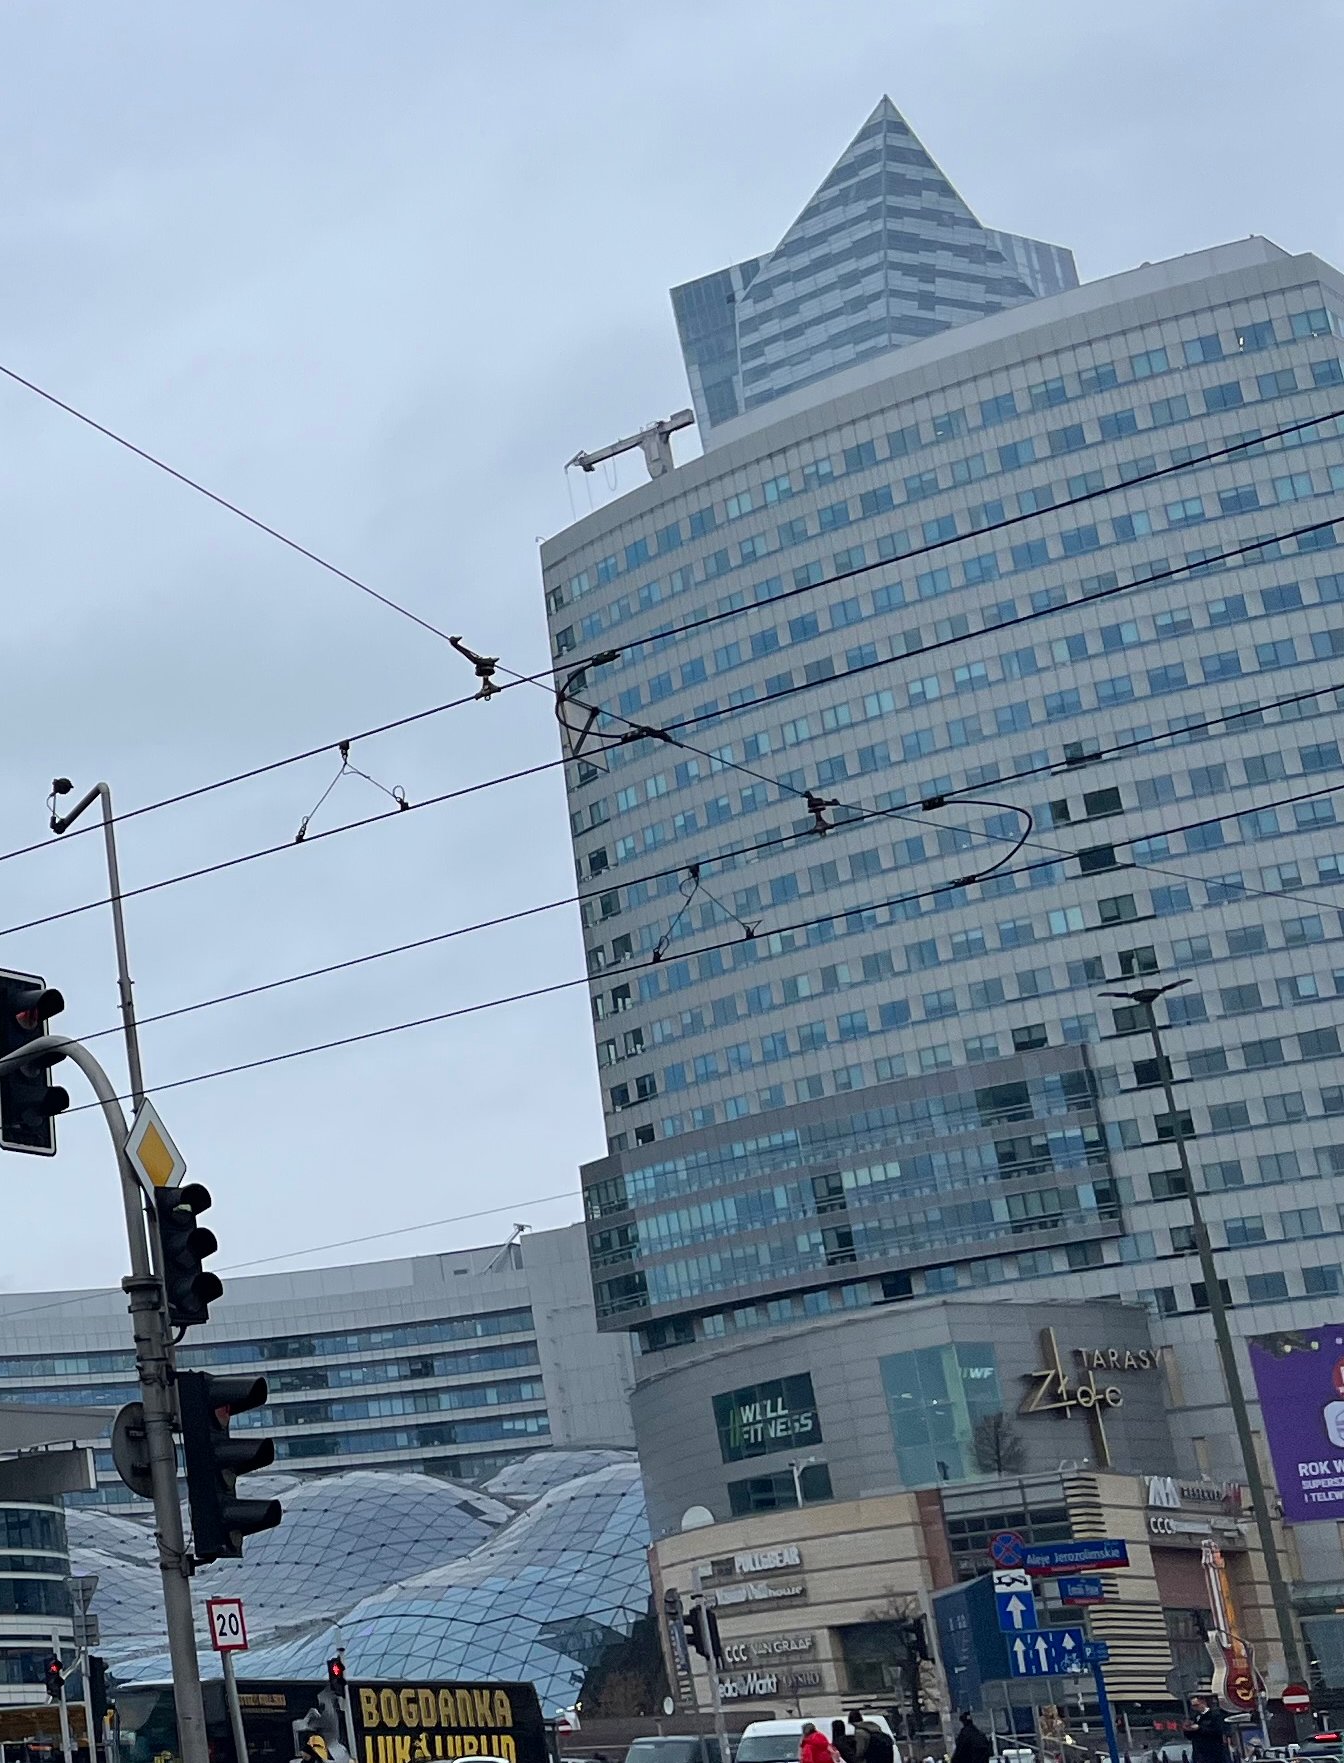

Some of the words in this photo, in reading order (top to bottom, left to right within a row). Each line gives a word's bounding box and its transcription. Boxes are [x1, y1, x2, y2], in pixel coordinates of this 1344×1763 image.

[1077, 1347, 1161, 1369] TARASY
[742, 1411, 813, 1443] FITNESS
[1298, 1461, 1331, 1477] ROK
[1150, 1517, 1176, 1534] CCC
[1026, 1553, 1050, 1567] Aleje
[1054, 1544, 1121, 1563] Jerozolimskie
[216, 1612, 240, 1637] 20
[725, 1644, 747, 1663] CCC
[774, 1637, 812, 1653] GRAAF
[359, 1688, 513, 1728] BOGDANKA
